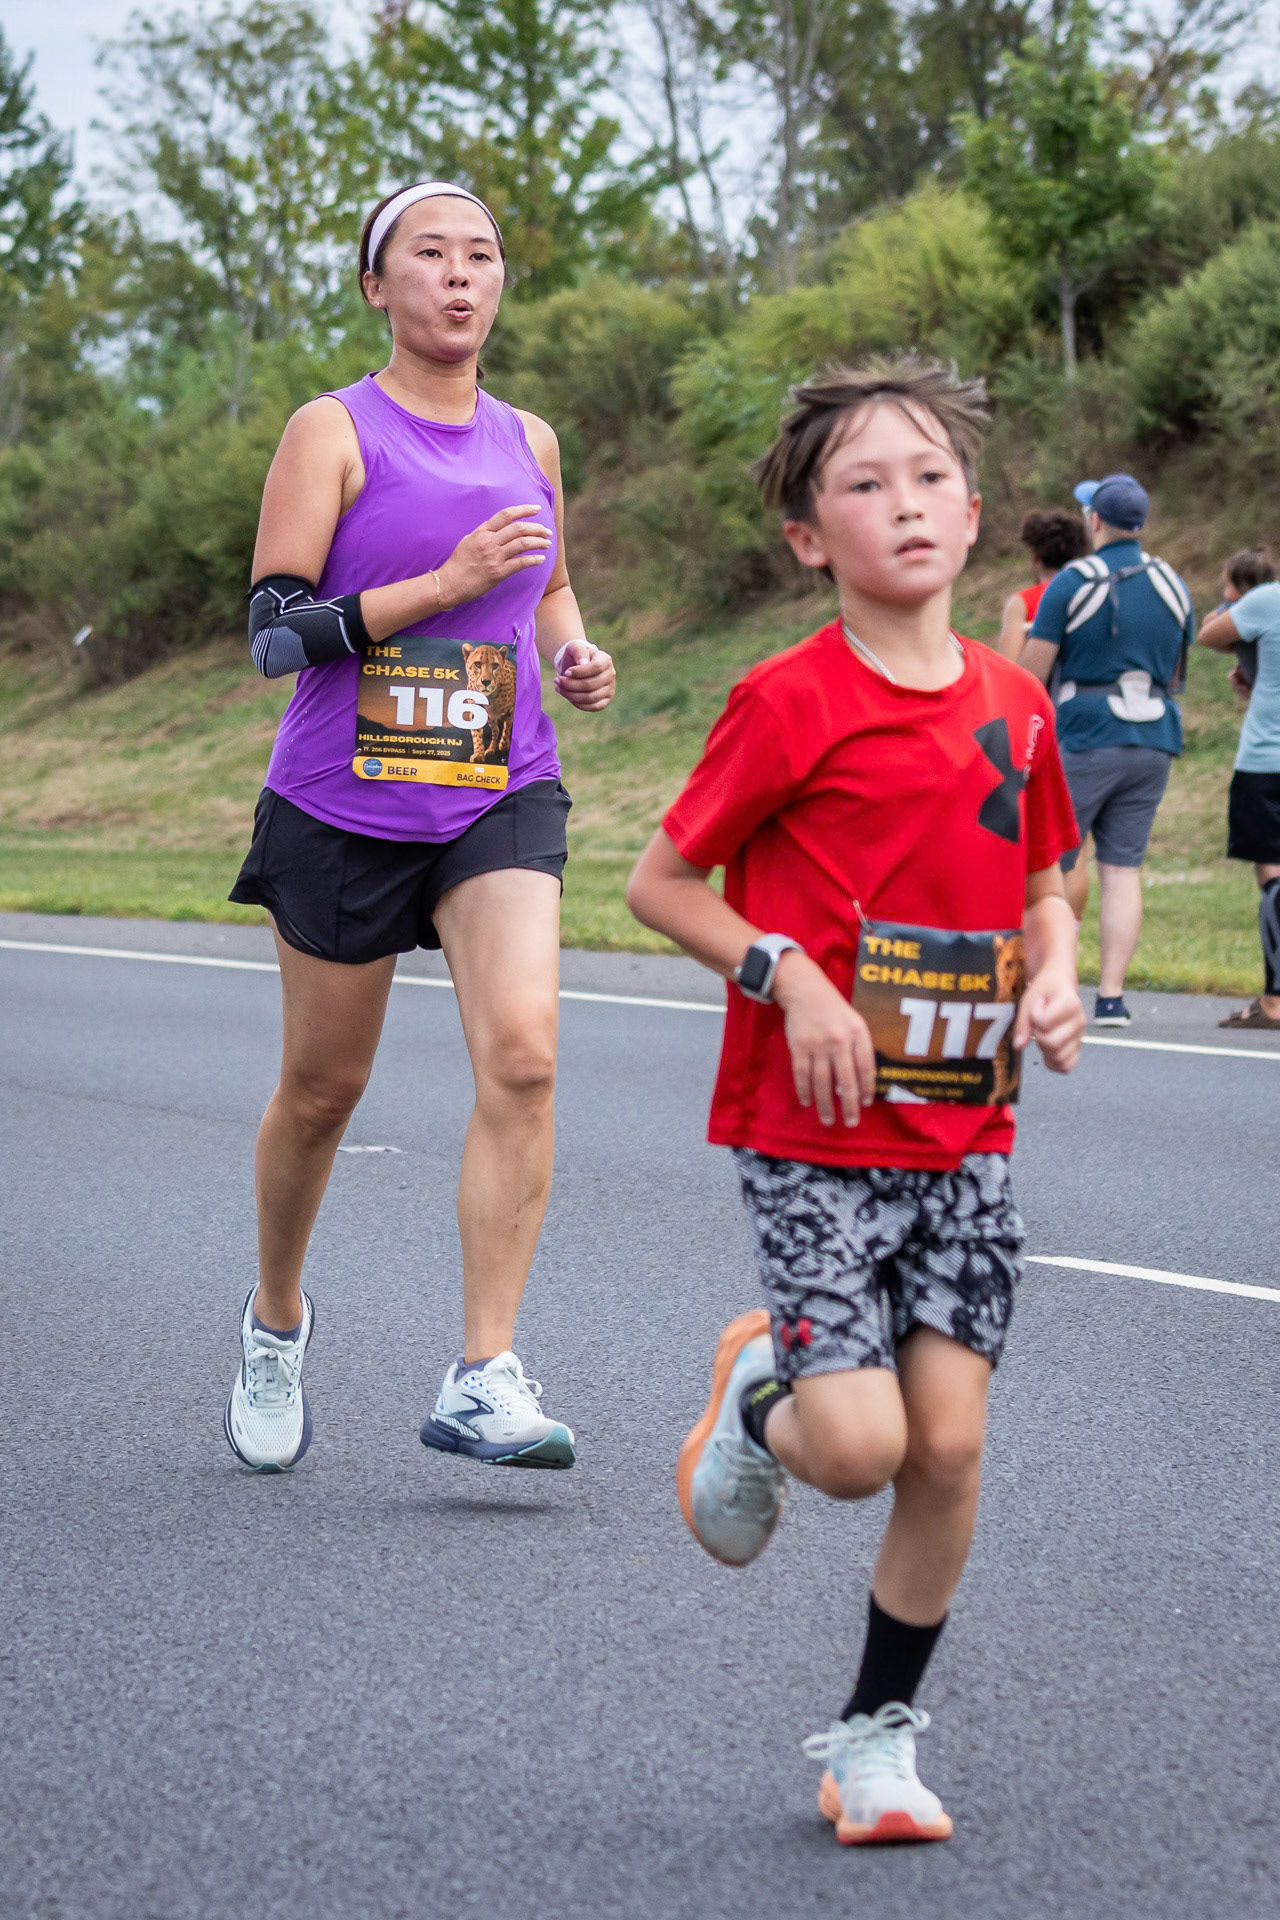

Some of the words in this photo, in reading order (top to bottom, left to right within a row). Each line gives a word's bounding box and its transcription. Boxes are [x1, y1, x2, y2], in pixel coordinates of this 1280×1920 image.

[366, 645, 402, 658] THE
[362, 664, 431, 679] CHASE
[433, 668, 460, 681] 5K
[389, 685, 490, 730] 116
[447, 738, 463, 747] NJ
[387, 765, 418, 777] BEER
[456, 773, 473, 783] BAG
[475, 775, 501, 785] CHECK
[863, 935, 922, 960] THE
[859, 963, 956, 991] CHASE
[900, 996, 1016, 1060] 117
